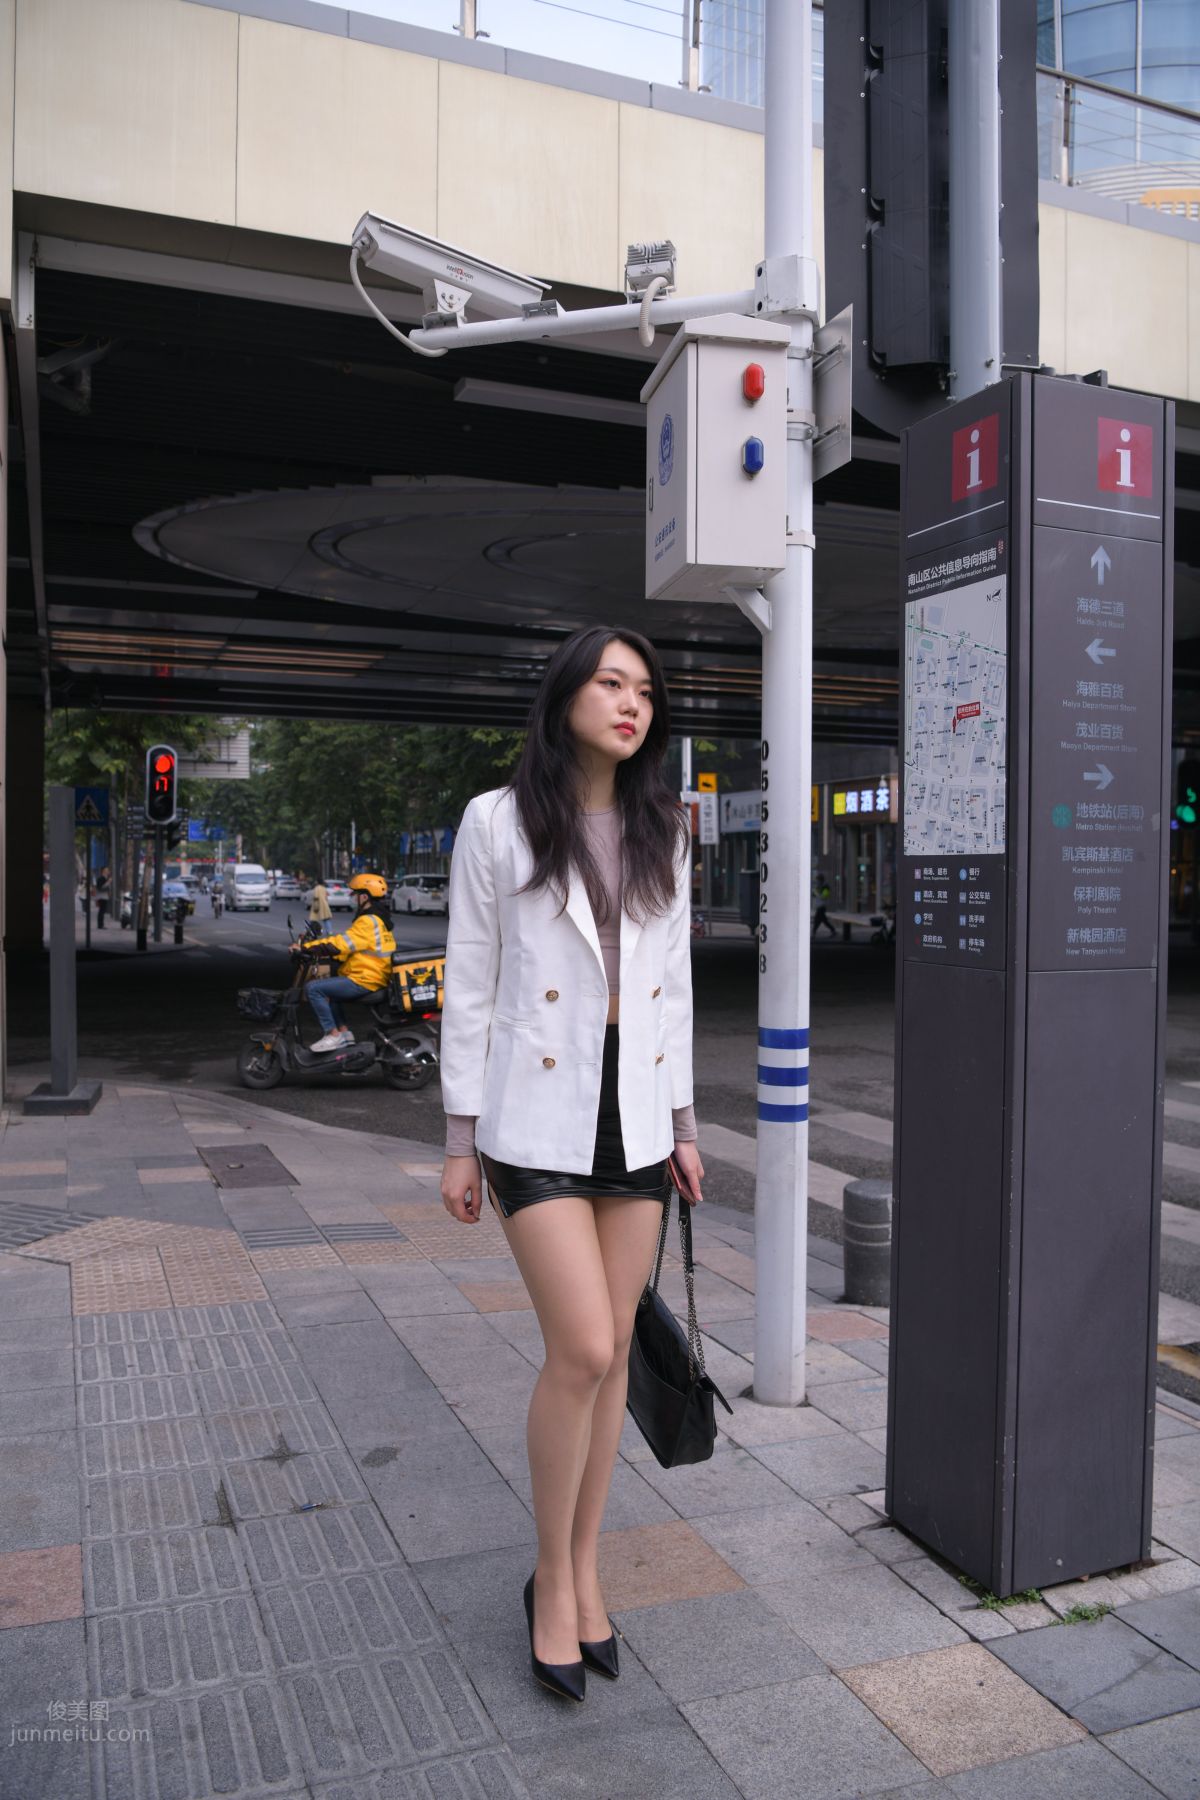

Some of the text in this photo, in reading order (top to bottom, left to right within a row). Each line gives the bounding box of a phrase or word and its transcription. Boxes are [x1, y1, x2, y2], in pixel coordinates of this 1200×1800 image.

[907, 546, 997, 588] 南山区公共信息导向指南
[926, 579, 942, 589] District
[956, 569, 982, 582] Information
[983, 563, 997, 573] Guide
[1076, 597, 1125, 616] 海德三道
[1076, 680, 1125, 699] 海雅百货
[1082, 701, 1119, 712] Department
[1076, 721, 1124, 740] 茂业百货
[1083, 742, 1120, 753] Department
[1075, 823, 1094, 831] Metro
[759, 740, 769, 974] 05530238
[1062, 846, 1135, 862] 凯宾斯基酒店
[1072, 866, 1106, 875] Kempinski
[969, 891, 991, 900] 公交车站
[1073, 886, 1121, 902] 保利剧院
[1078, 905, 1092, 915] Poly
[969, 938, 985, 947] 停车场
[1067, 927, 1127, 944] 新桃园酒店
